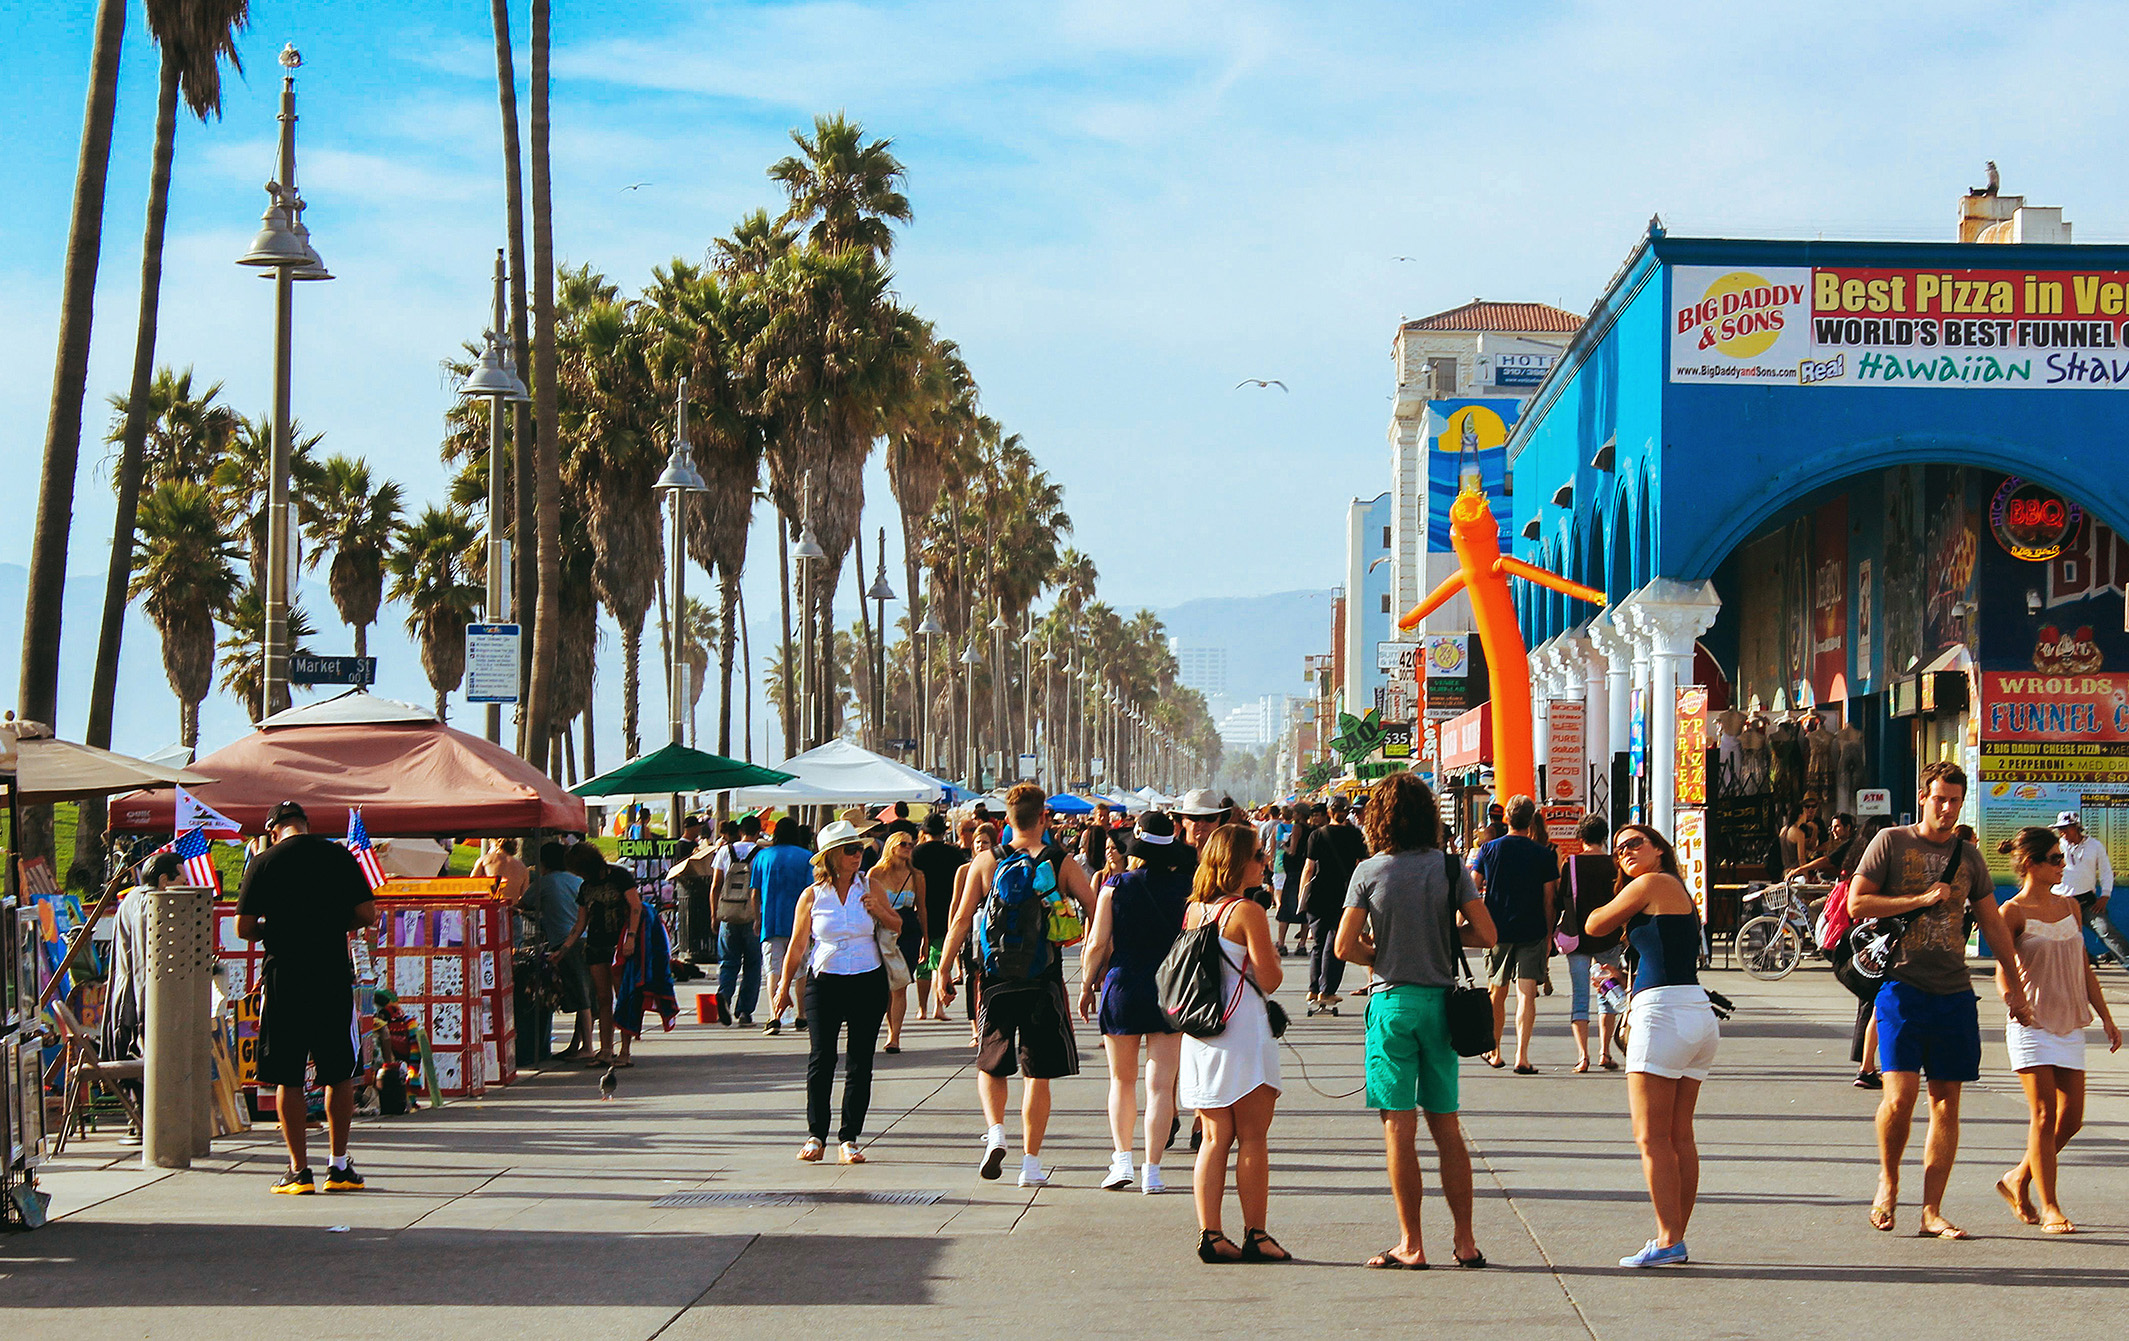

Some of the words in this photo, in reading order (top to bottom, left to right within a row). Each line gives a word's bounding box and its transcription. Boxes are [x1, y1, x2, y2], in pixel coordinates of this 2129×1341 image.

[1814, 272, 1907, 313] Best
[1915, 274, 2014, 315] Pizza
[2024, 275, 2063, 315] in
[2072, 276, 2129, 316] Ve
[1677, 297, 1718, 335] BIG
[1722, 284, 1805, 316] DADDY
[1697, 325, 1717, 351] &
[1720, 309, 1785, 341] SONS
[1815, 319, 1938, 346] WORLD'S
[1944, 321, 2012, 347] BEST
[2018, 322, 2116, 348] FUNNEL
[1677, 364, 1797, 380] www.BigDaddyandSons.com
[2010, 499, 2065, 528] BBQ
[296, 659, 342, 673] Market
[356, 658, 371, 673] St
[1998, 677, 2114, 695] WROLDS
[1989, 702, 2103, 733] FUNNEL
[1985, 743, 1992, 754] 2
[1993, 743, 2010, 755] BIG
[2011, 744, 2041, 755] DADDY
[2043, 744, 2076, 755] CHEESE
[2077, 745, 2100, 755] PIZZA
[1690, 718, 1704, 801] PIZZA
[1998, 759, 2006, 769] 2
[2008, 759, 2065, 770] PEPPERONI
[2077, 761, 2104, 770] MED
[1984, 771, 2019, 781] BIG
[2023, 772, 2089, 782] DADDY
[1863, 793, 1884, 802] ATM
[618, 840, 653, 857] HENNA
